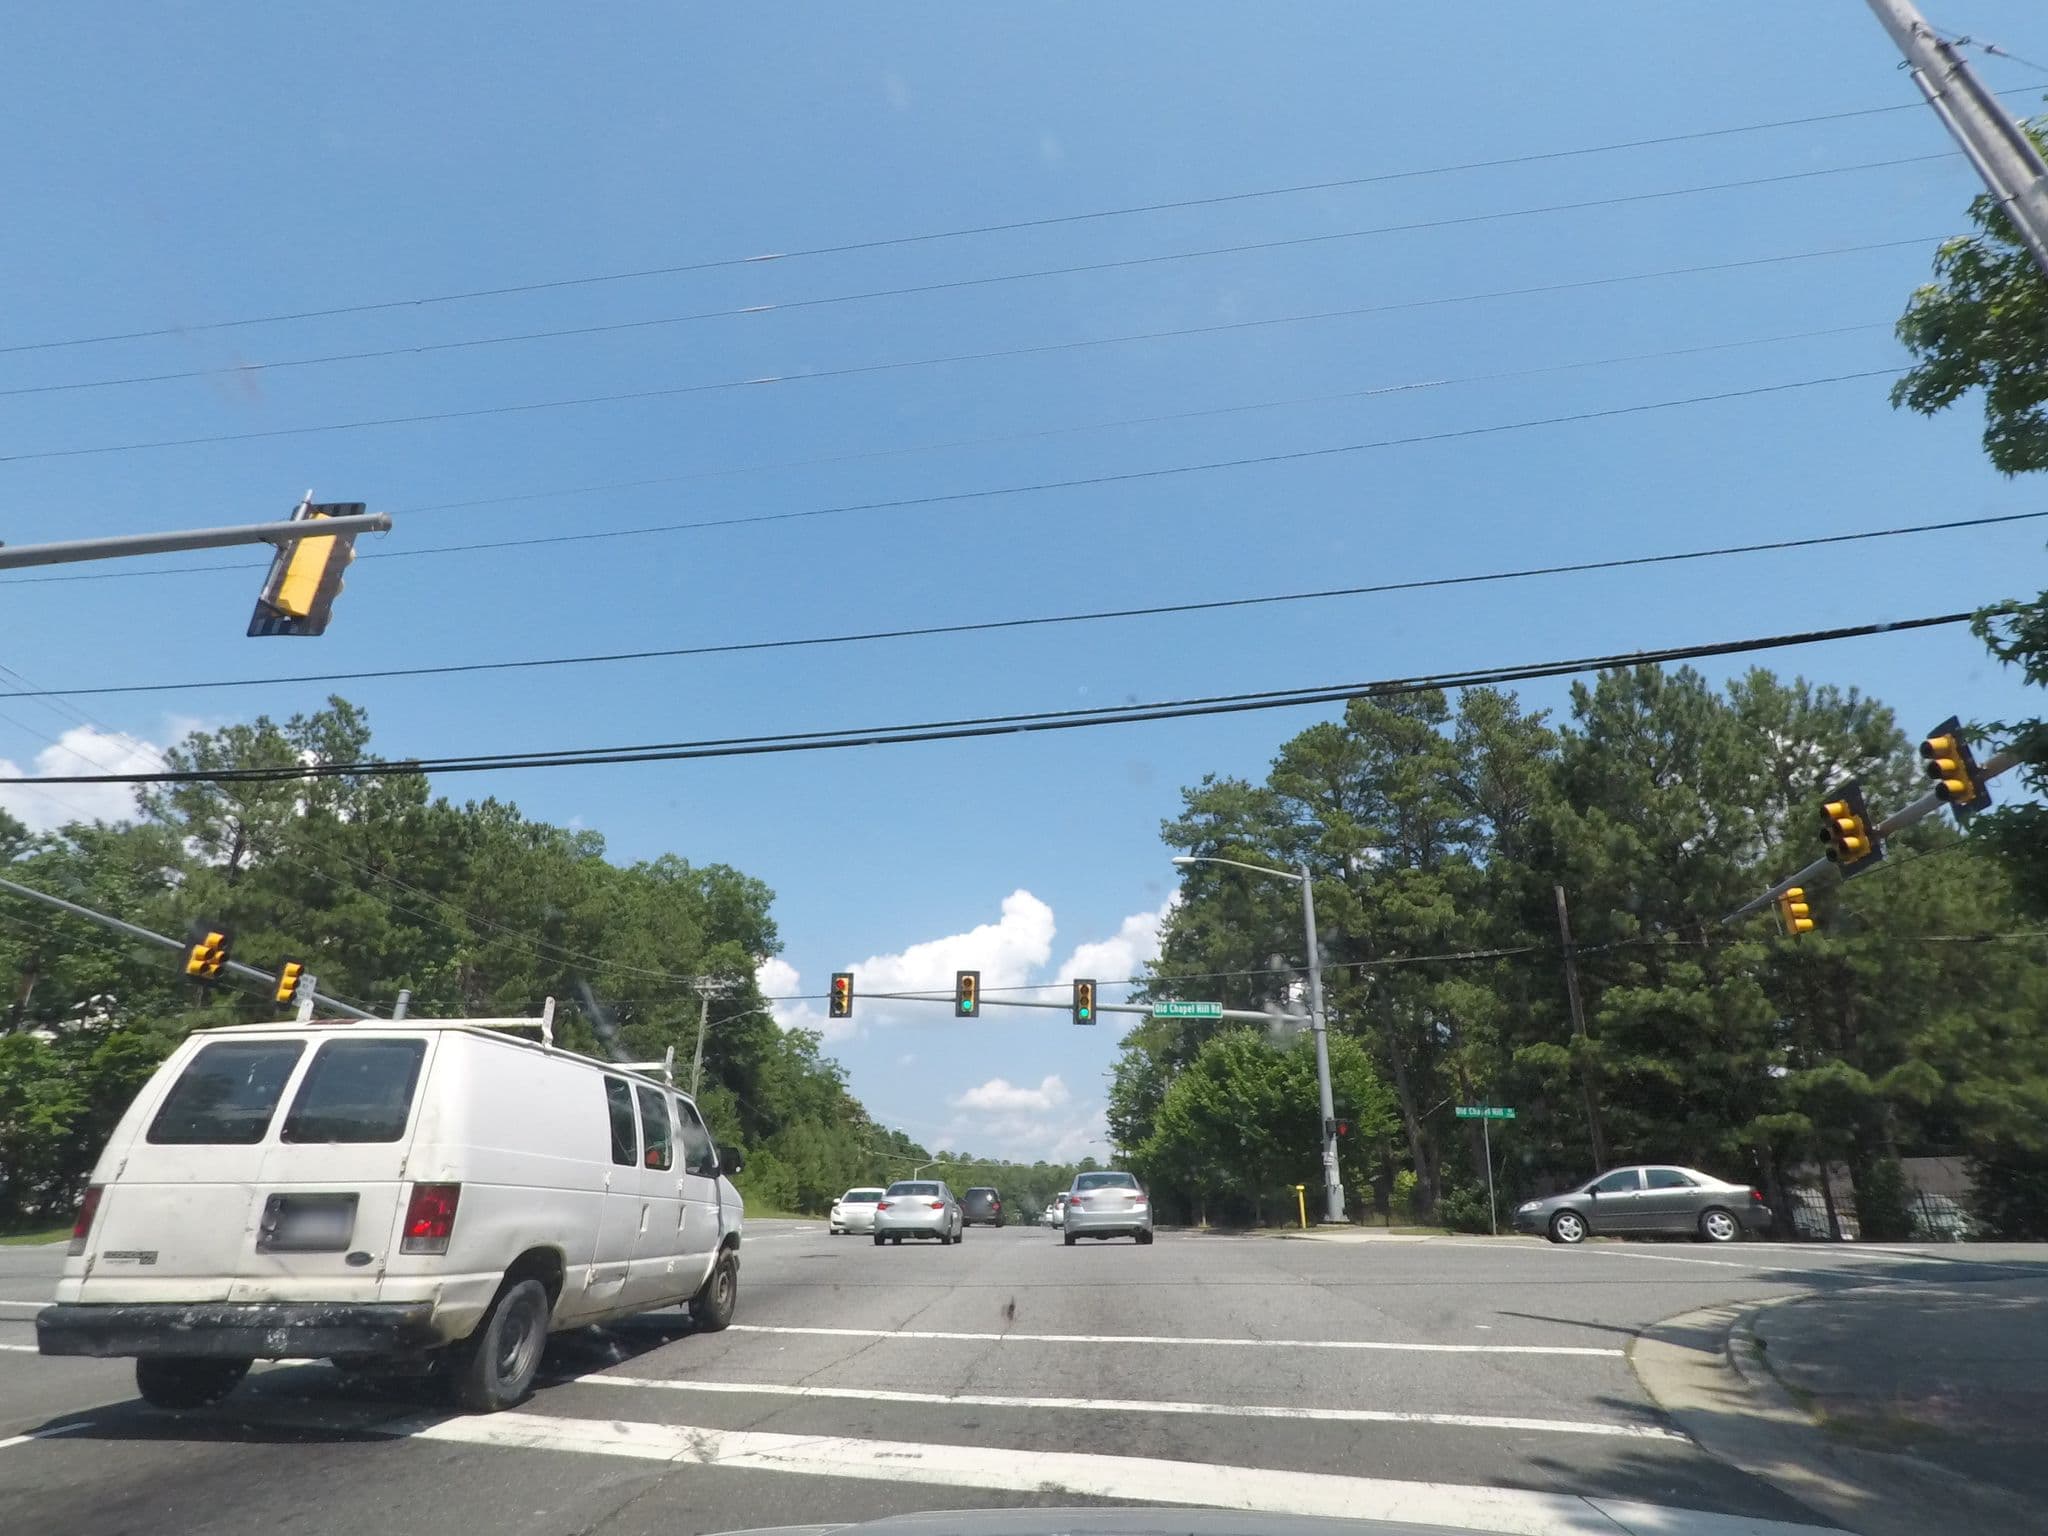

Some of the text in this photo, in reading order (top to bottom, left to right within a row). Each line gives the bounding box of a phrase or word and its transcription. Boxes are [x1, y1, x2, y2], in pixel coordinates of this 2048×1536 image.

[1155, 1003, 1220, 1015] Old Chapel Hill Rd
[1455, 1107, 1467, 1115] Old
[1469, 1107, 1490, 1116] Chael
[1491, 1107, 1504, 1116] Hill
